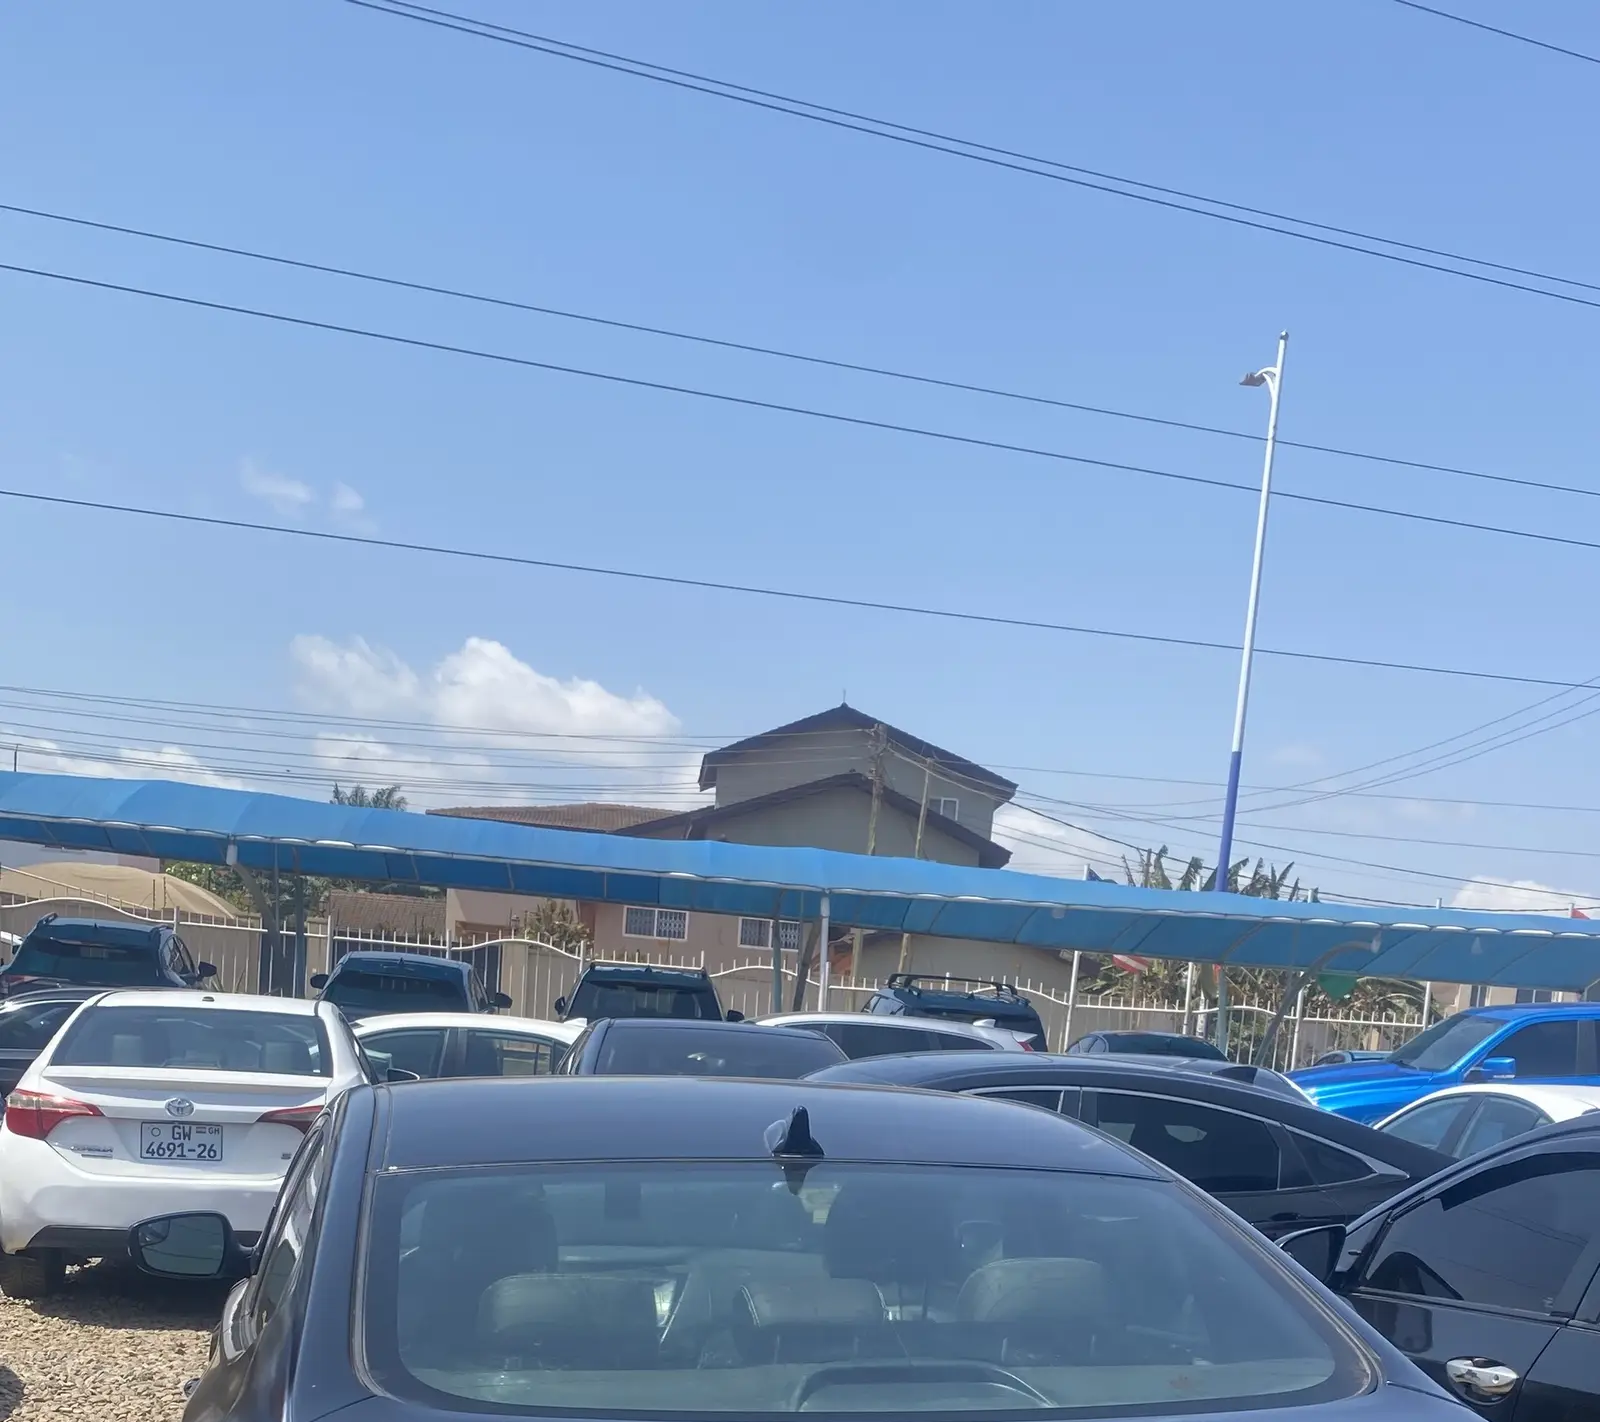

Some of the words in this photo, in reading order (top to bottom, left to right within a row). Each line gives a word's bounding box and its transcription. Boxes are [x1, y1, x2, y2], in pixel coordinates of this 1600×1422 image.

[172, 1125, 192, 1141] GW
[208, 1127, 220, 1135] GH
[146, 1142, 217, 1159] 4691-26
